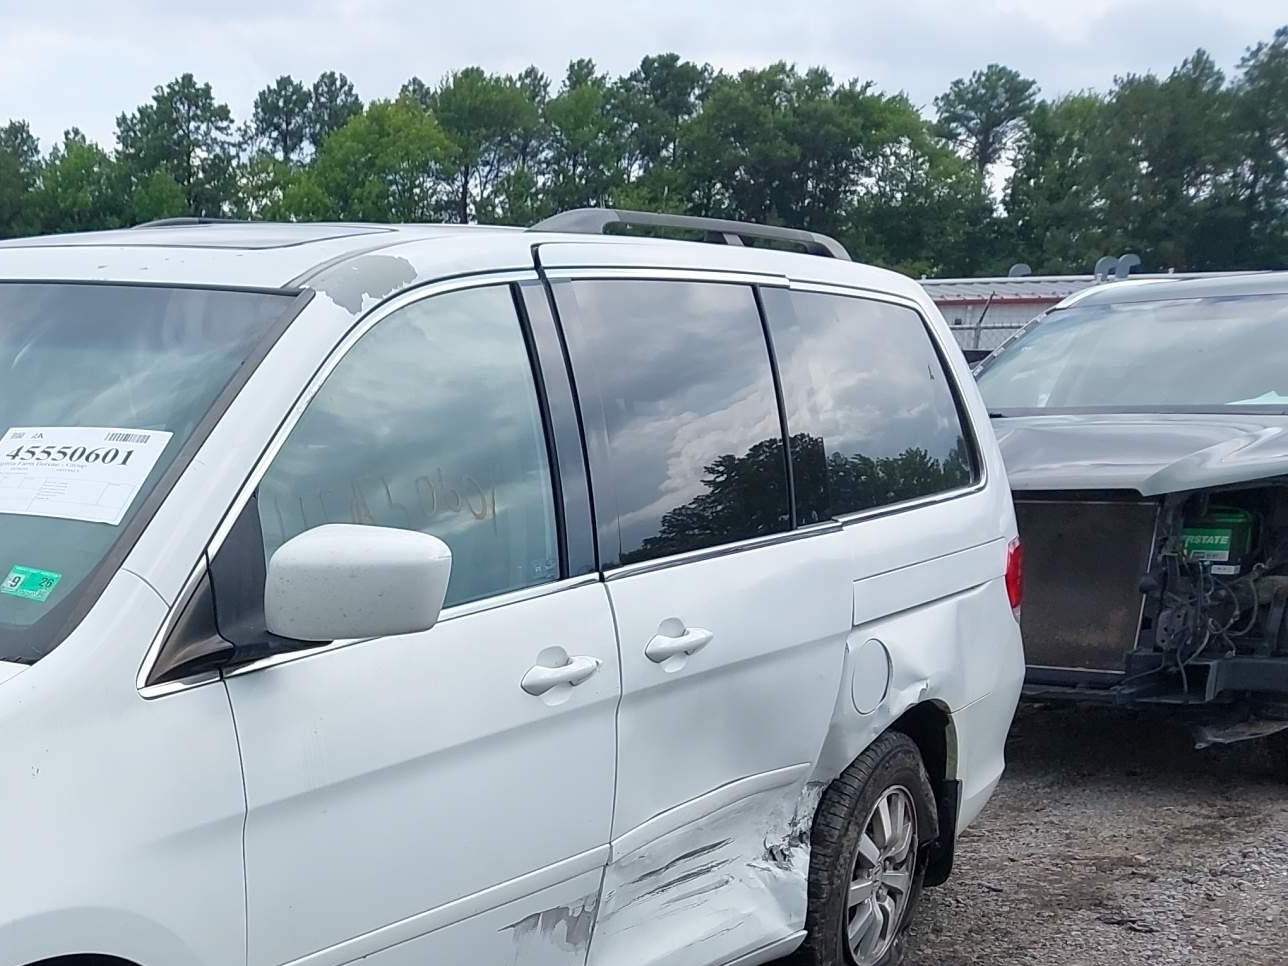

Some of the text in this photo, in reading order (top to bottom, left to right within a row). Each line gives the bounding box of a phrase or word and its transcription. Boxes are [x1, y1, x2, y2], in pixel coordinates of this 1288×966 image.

[6, 445, 134, 466] 45550601
[9, 576, 55, 588] 9 26
